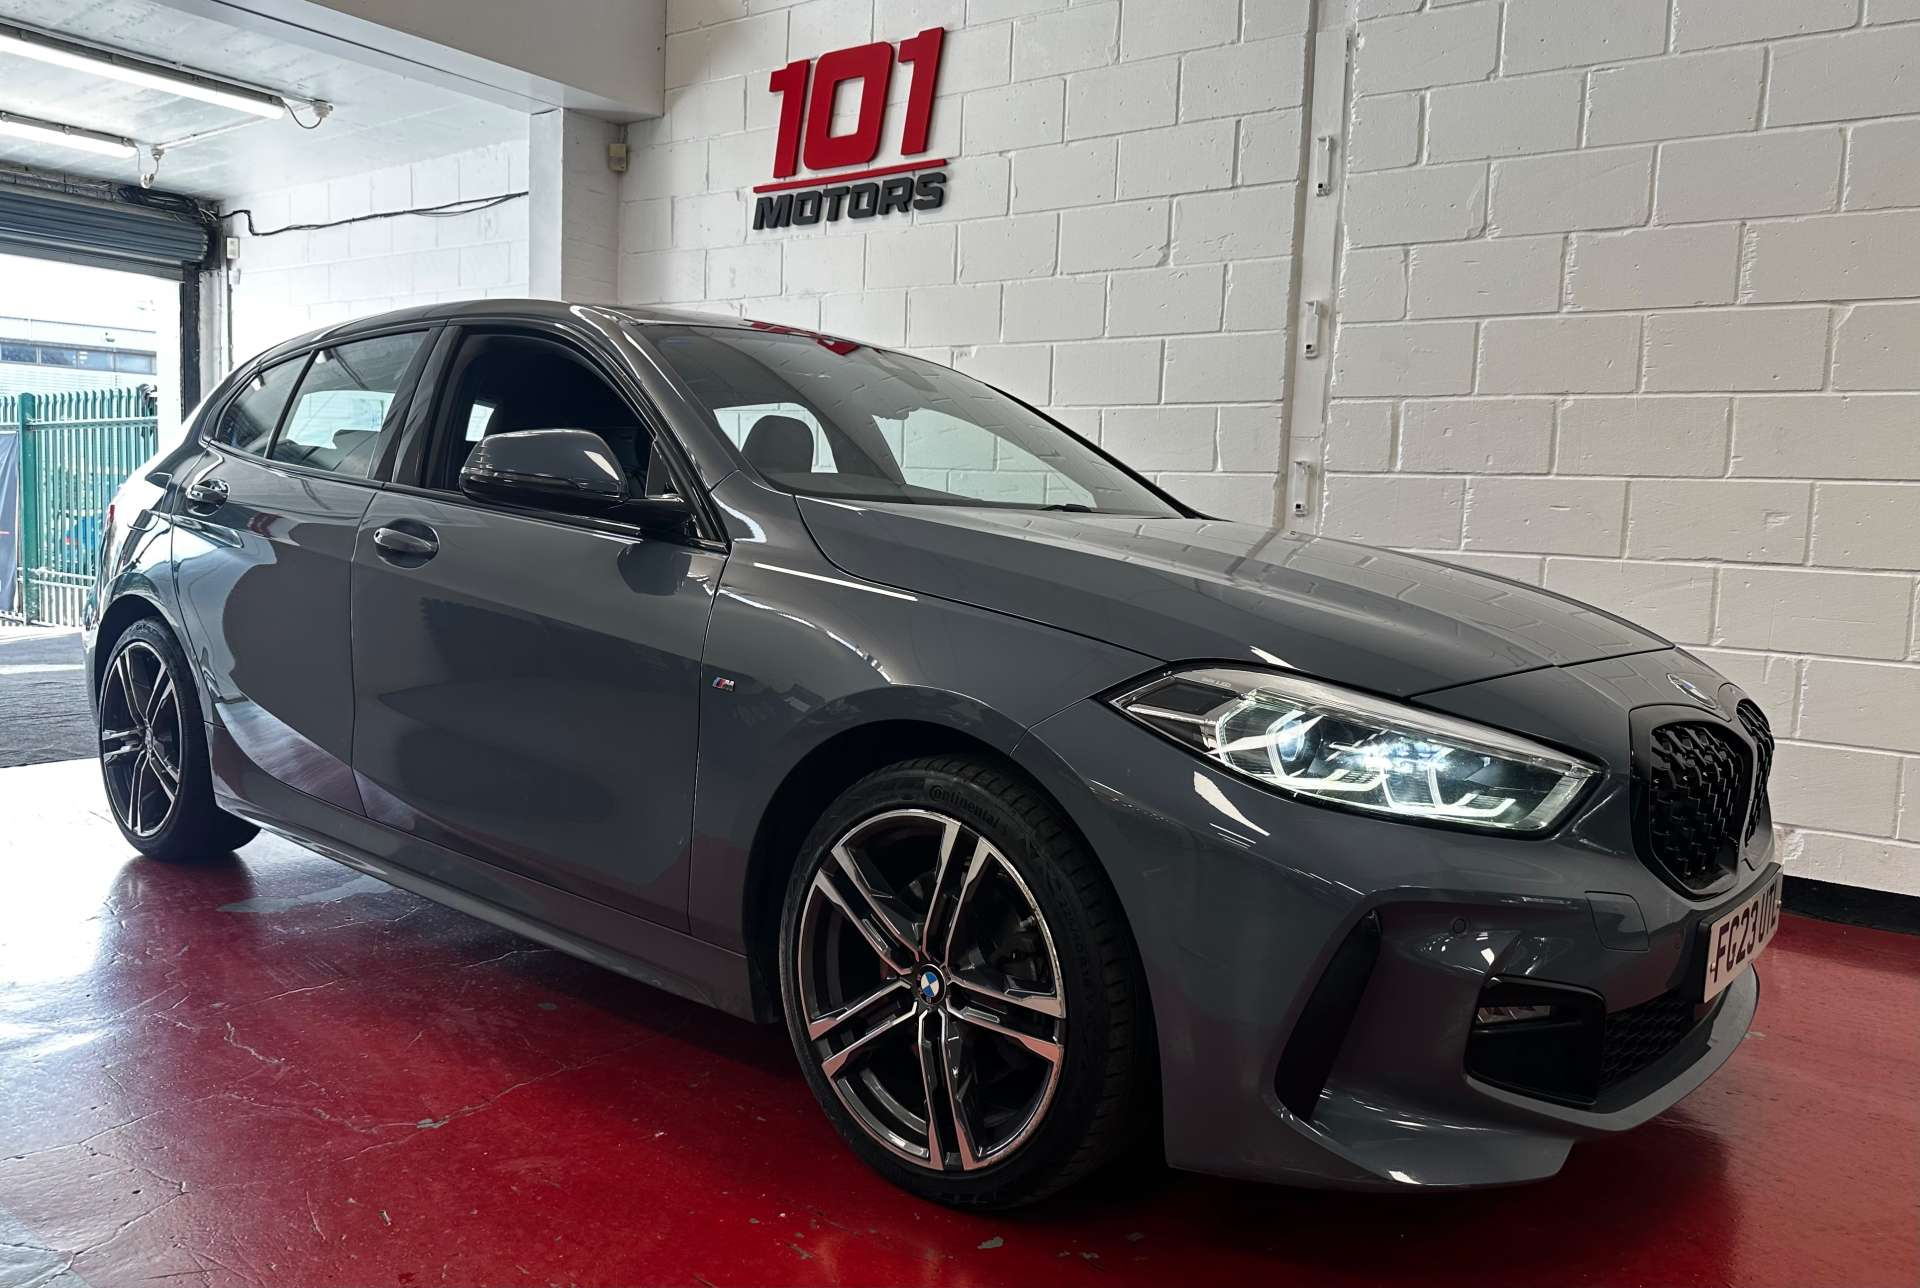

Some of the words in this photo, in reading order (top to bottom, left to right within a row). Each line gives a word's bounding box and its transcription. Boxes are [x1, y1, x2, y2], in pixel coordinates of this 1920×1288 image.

[769, 27, 944, 178] 101
[753, 172, 947, 230] MOTORS
[1714, 900, 1758, 983] FG23
